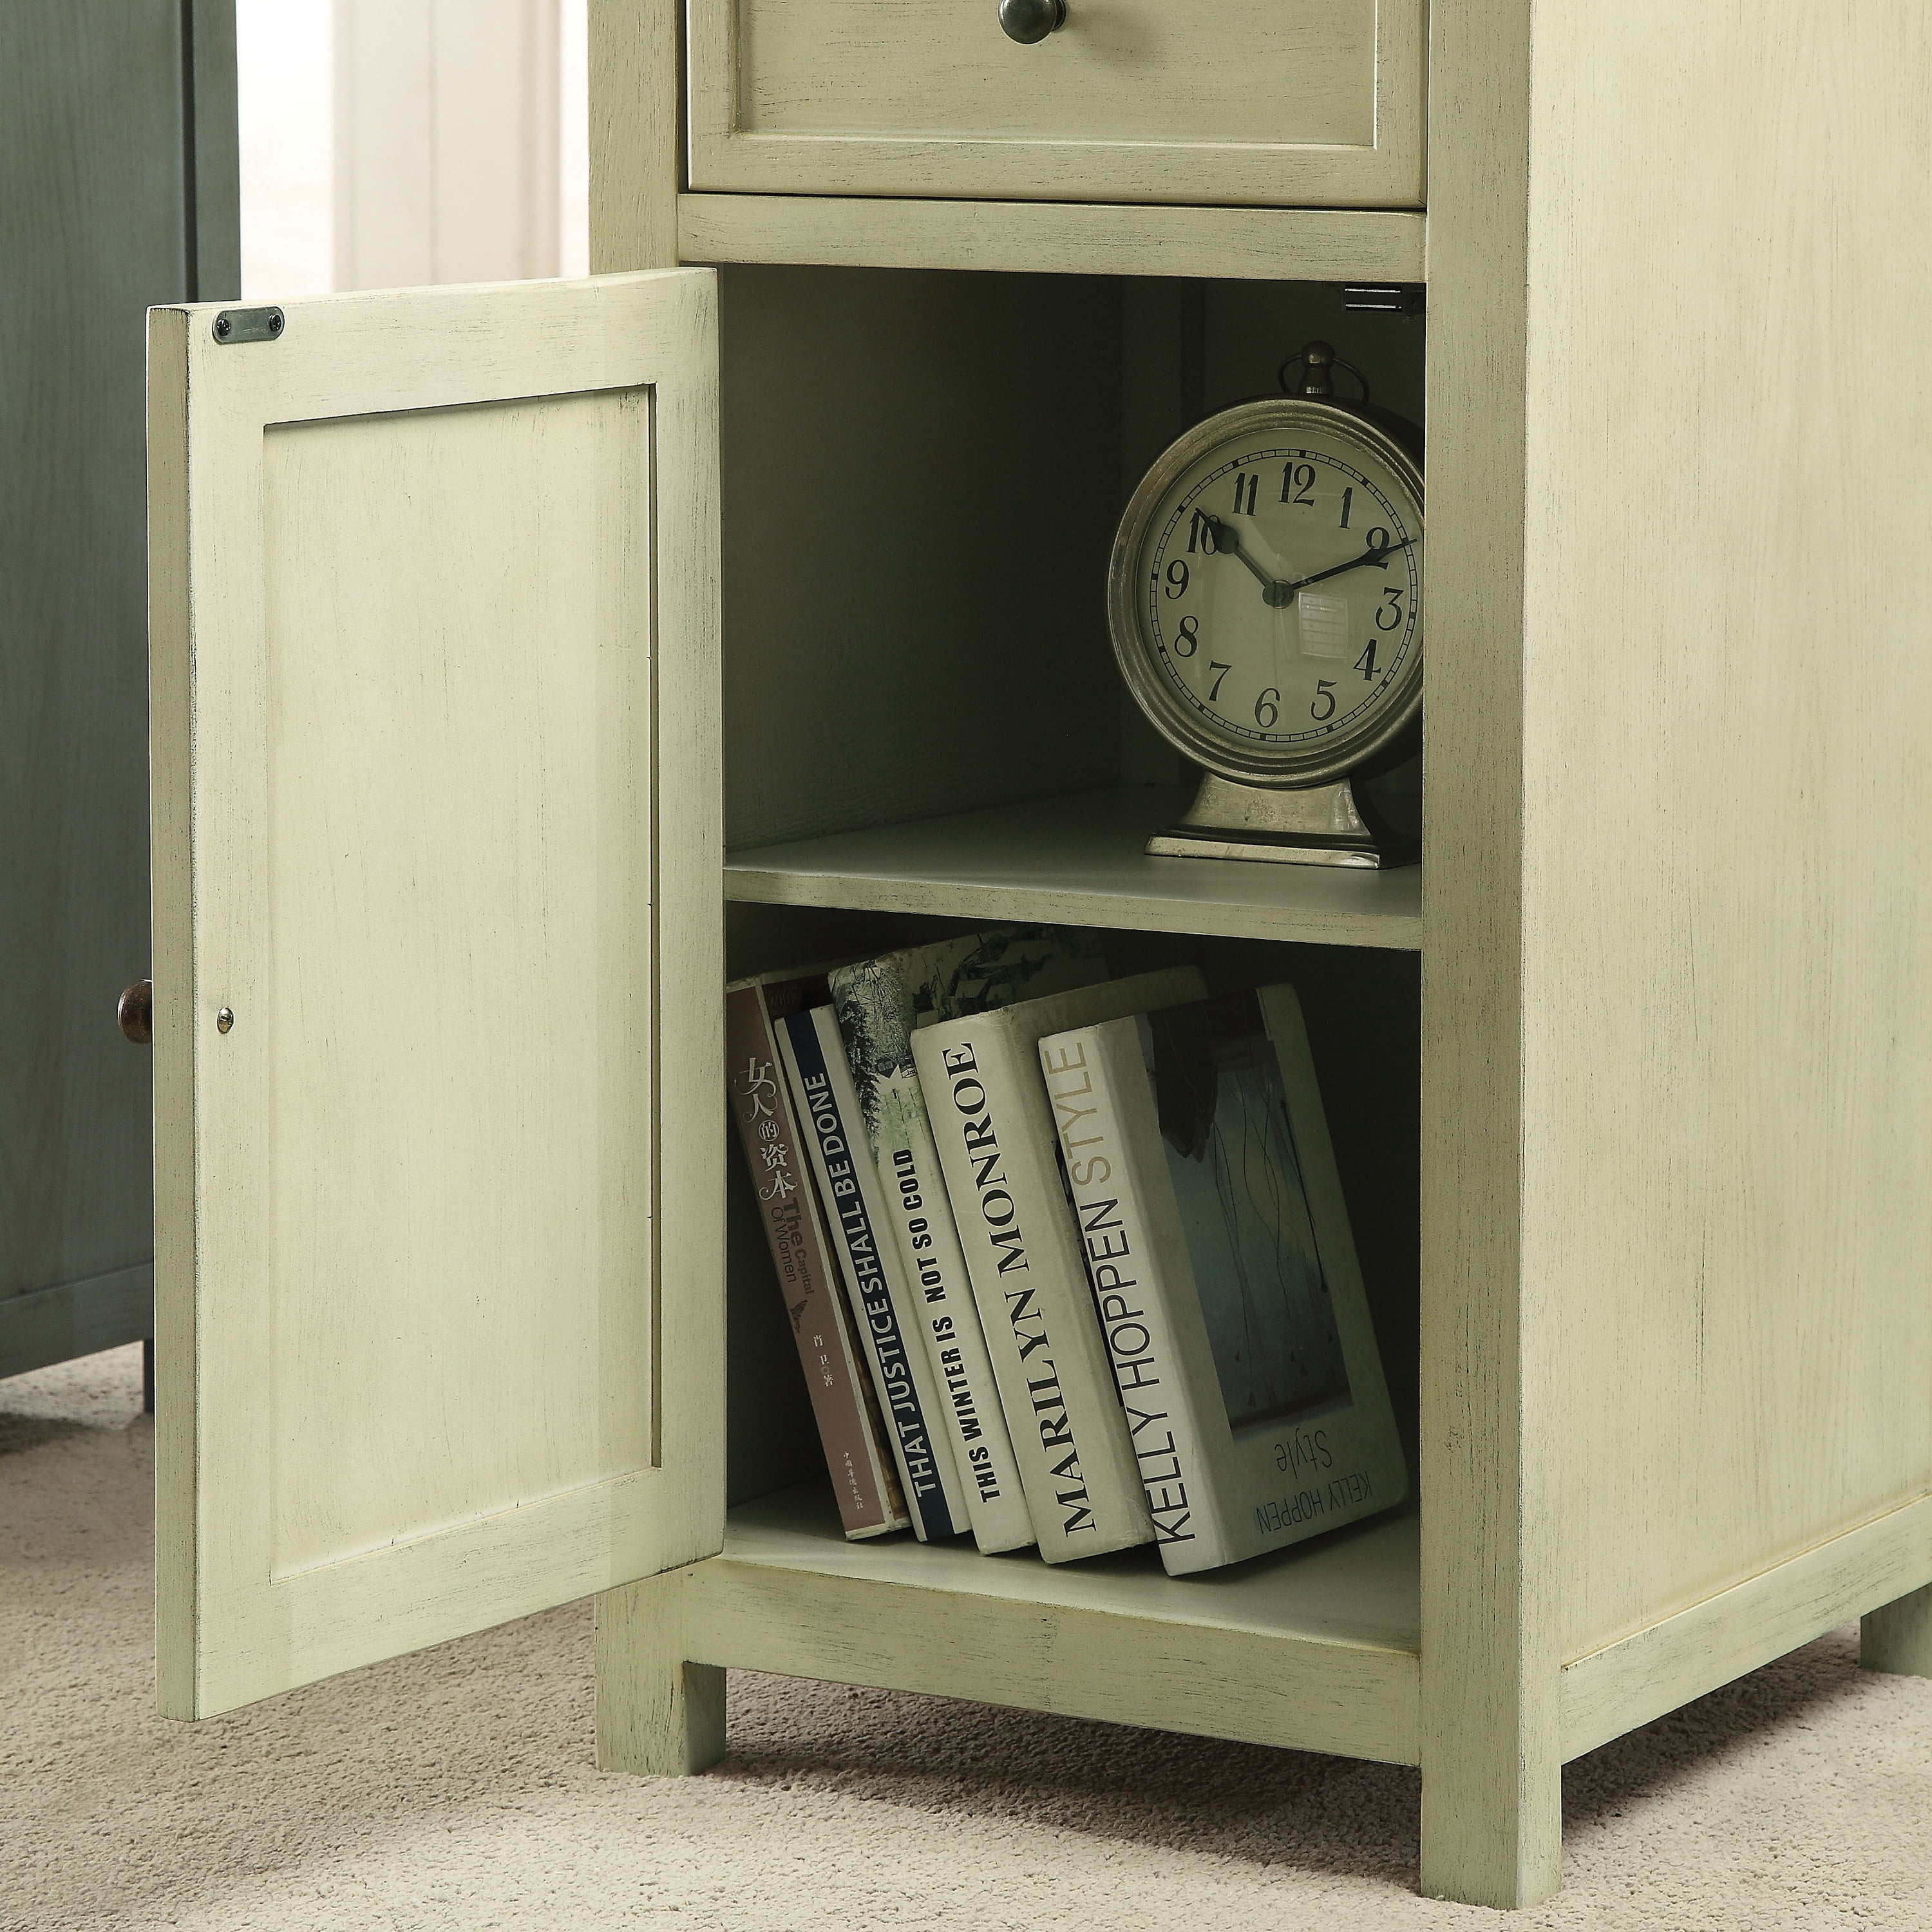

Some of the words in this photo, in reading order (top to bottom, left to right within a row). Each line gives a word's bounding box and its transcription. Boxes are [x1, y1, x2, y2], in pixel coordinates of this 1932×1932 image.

[1232, 472, 1259, 516] 11
[1278, 461, 1316, 506] 12
[1339, 487, 1354, 529] 1
[1365, 527, 1390, 569] 2
[1165, 558, 1189, 600] 9
[1375, 587, 1403, 632] 3
[1174, 616, 1198, 658] 8
[1352, 638, 1381, 681] 4
[1209, 660, 1231, 701] 7
[1310, 679, 1336, 721] 5
[1255, 687, 1280, 728] 6
[734, 1057, 797, 1200] 女人的资本
[804, 1072, 846, 1157] DONE
[1044, 1041, 1112, 1188] STYLE
[829, 1160, 855, 1198] BE
[893, 1149, 923, 1212] COLD
[942, 1042, 1030, 1278] MONROE
[771, 1206, 788, 1225] Of
[782, 1197, 804, 1251] The
[907, 1217, 933, 1250] SO
[777, 1223, 797, 1283] Women
[840, 1200, 882, 1295] SHALL
[916, 1256, 947, 1303] NOT
[1079, 1197, 1161, 1393] HOPPEN
[932, 1315, 957, 1342] IS
[866, 1300, 914, 1411] JUSTICE
[940, 1347, 983, 1441] WINTER
[1004, 1288, 1097, 1539] MARILYN
[897, 1419, 936, 1498] THAT
[969, 1446, 1001, 1503] THIS
[1125, 1399, 1197, 1547] KELLY
[1274, 1427, 1332, 1479] Style
[1256, 1488, 1325, 1534] HOPPEN
[1329, 1471, 1372, 1511] KELLY
